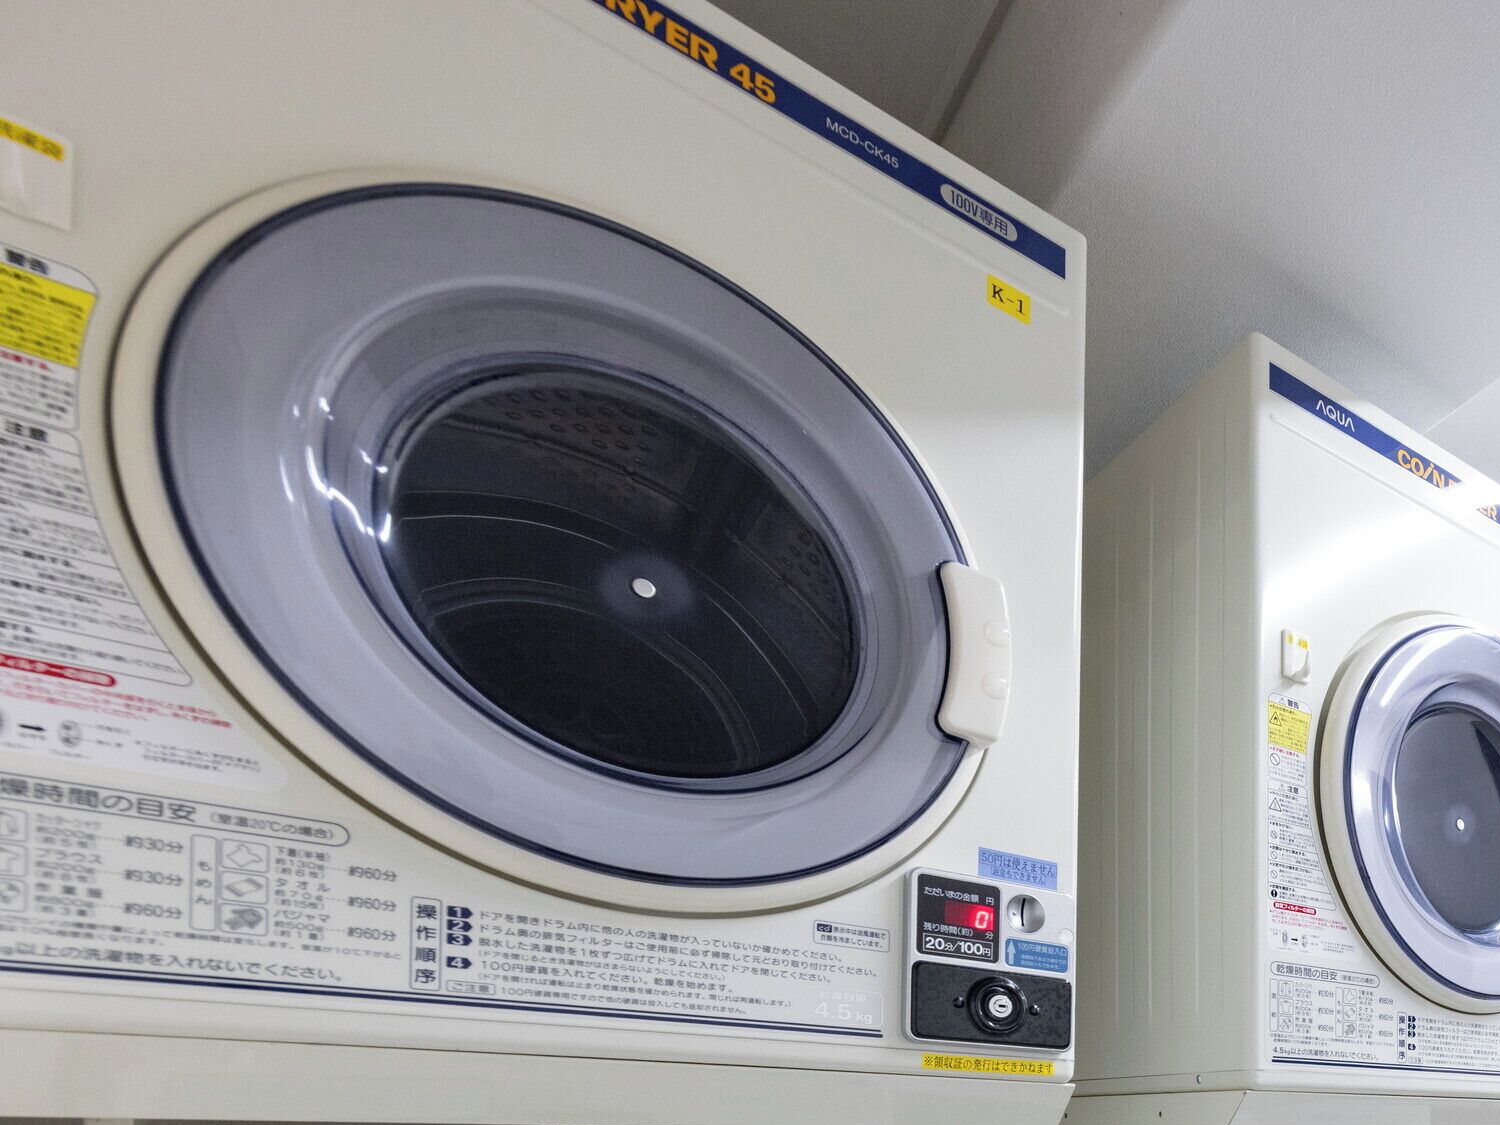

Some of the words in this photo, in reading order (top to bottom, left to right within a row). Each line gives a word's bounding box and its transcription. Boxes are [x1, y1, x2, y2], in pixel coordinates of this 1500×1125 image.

[729, 63, 776, 103] 45
[825, 116, 900, 169] MCD-CK45
[949, 189, 1008, 236] 100V専用
[991, 284, 1026, 316] K-1
[1315, 399, 1356, 432] AQUA
[414, 903, 438, 984] 操作順序
[924, 936, 992, 957] 20分/100円
